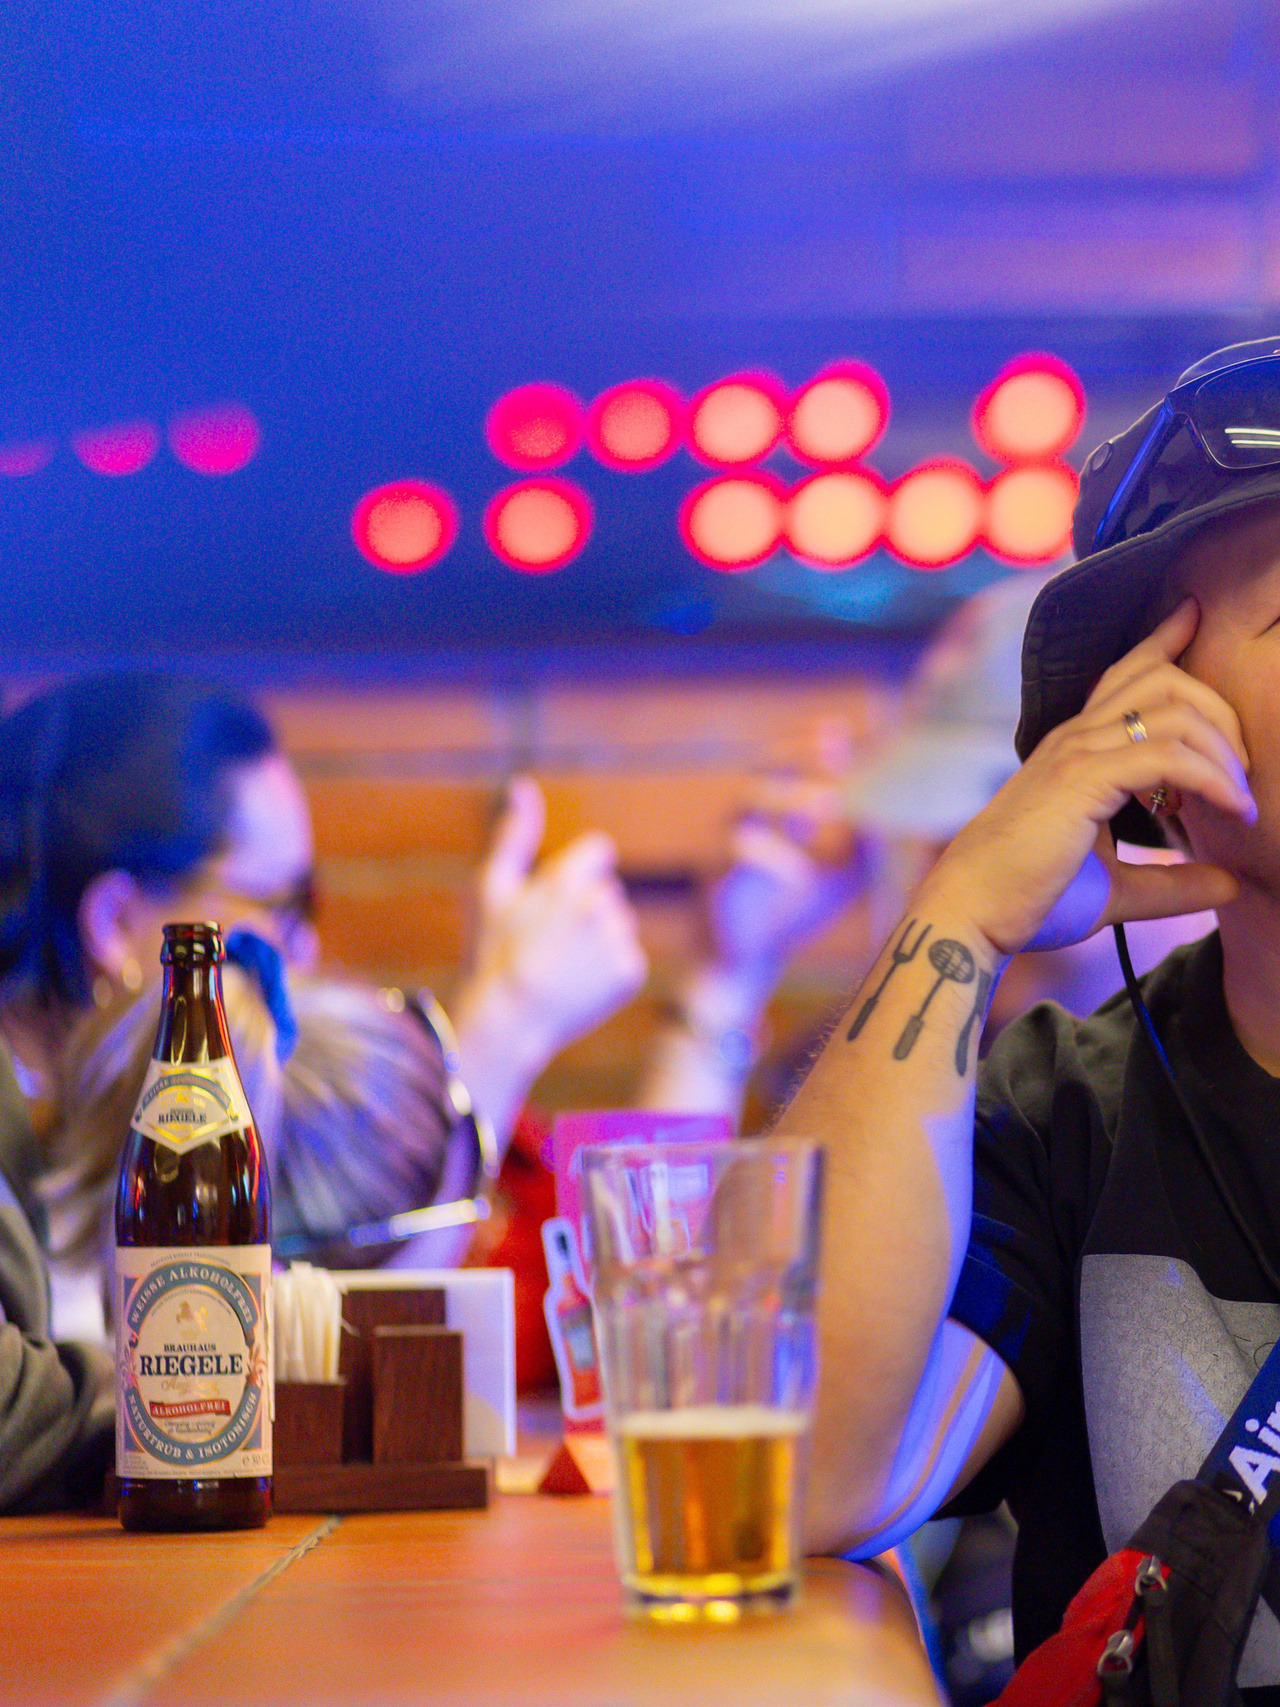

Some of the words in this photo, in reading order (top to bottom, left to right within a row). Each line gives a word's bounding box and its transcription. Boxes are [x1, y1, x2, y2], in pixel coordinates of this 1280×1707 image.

[131, 1275, 165, 1324] WEISSE
[163, 1343, 217, 1353] BRAUHAUS
[140, 1354, 243, 1376] RIEGELE
[152, 1400, 227, 1416] ALKOHOLFREI
[185, 1448, 195, 1461] &
